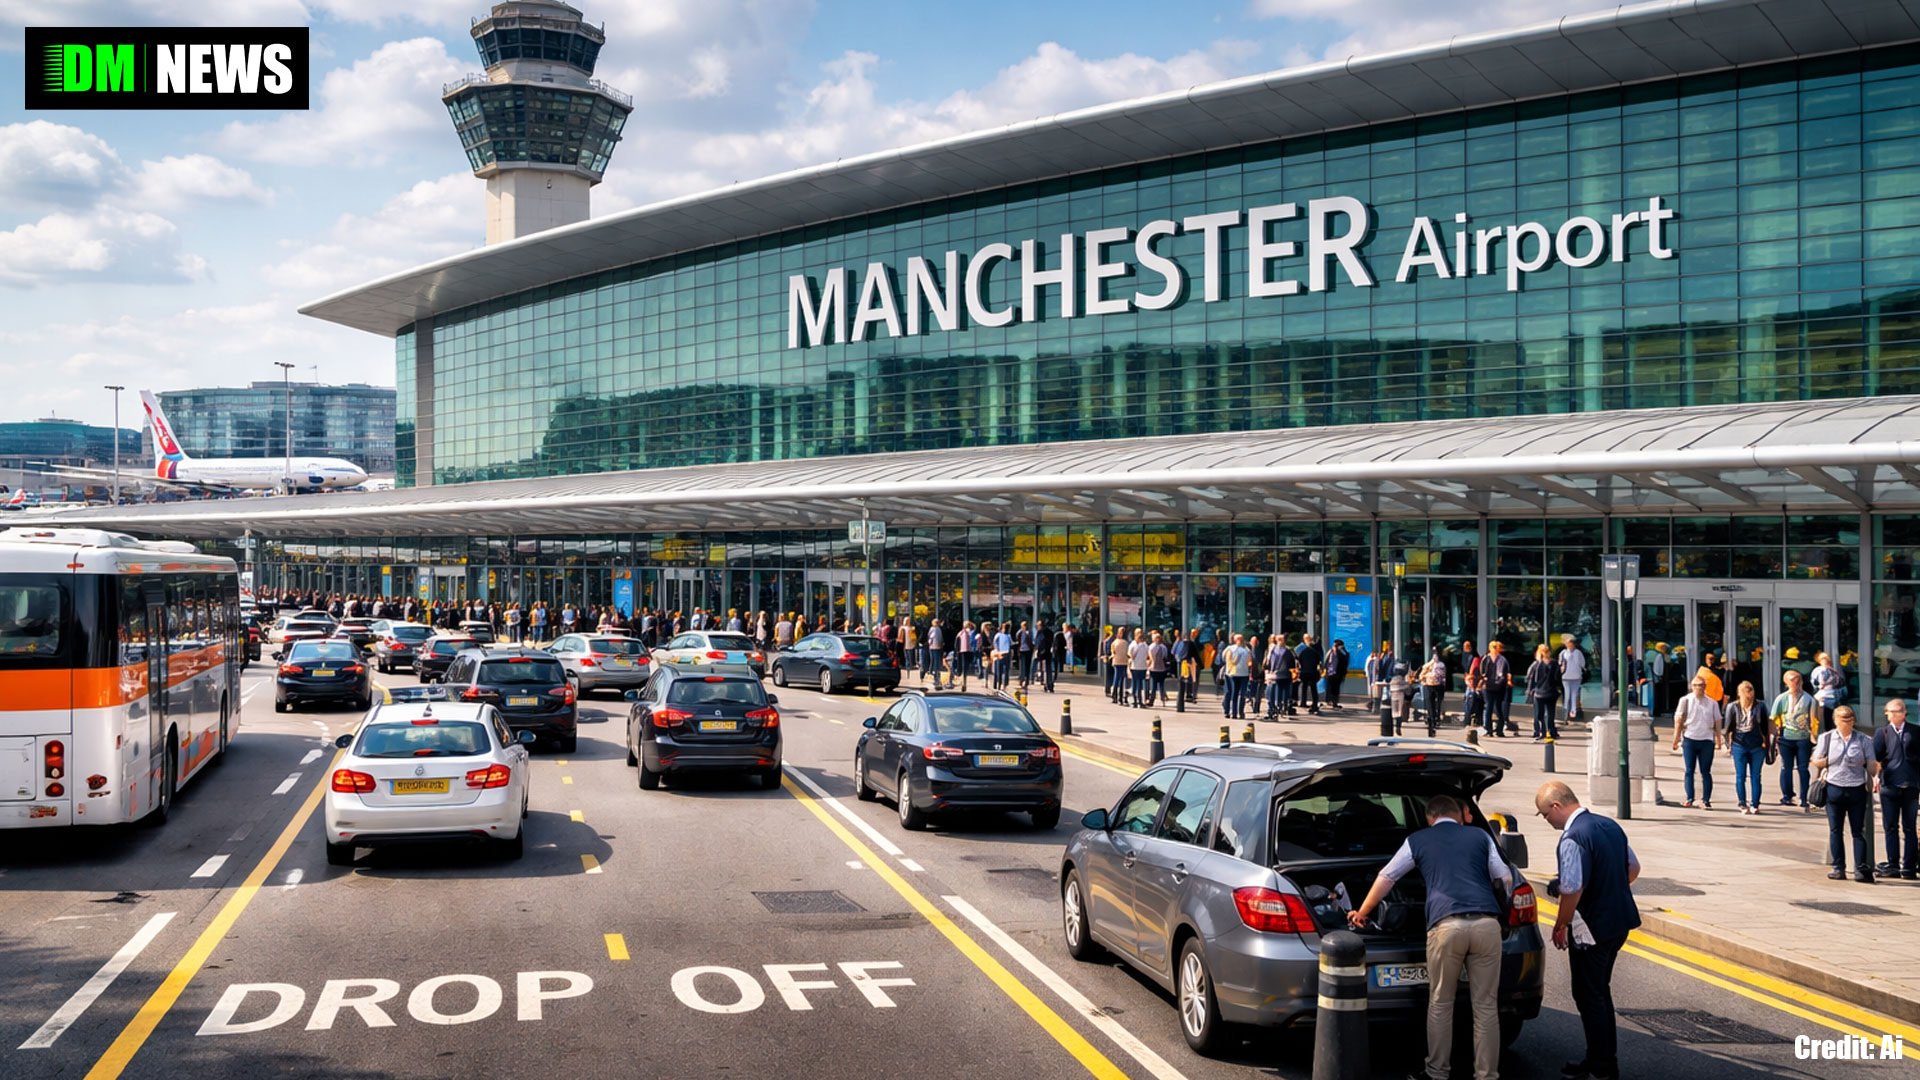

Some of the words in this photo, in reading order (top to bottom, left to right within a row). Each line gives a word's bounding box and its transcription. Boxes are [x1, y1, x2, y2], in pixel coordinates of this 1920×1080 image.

[787, 196, 1373, 349] MANCHESTER
[1395, 196, 1675, 290] Airport
[195, 970, 594, 1036] DROP
[671, 960, 916, 1014] OFF
